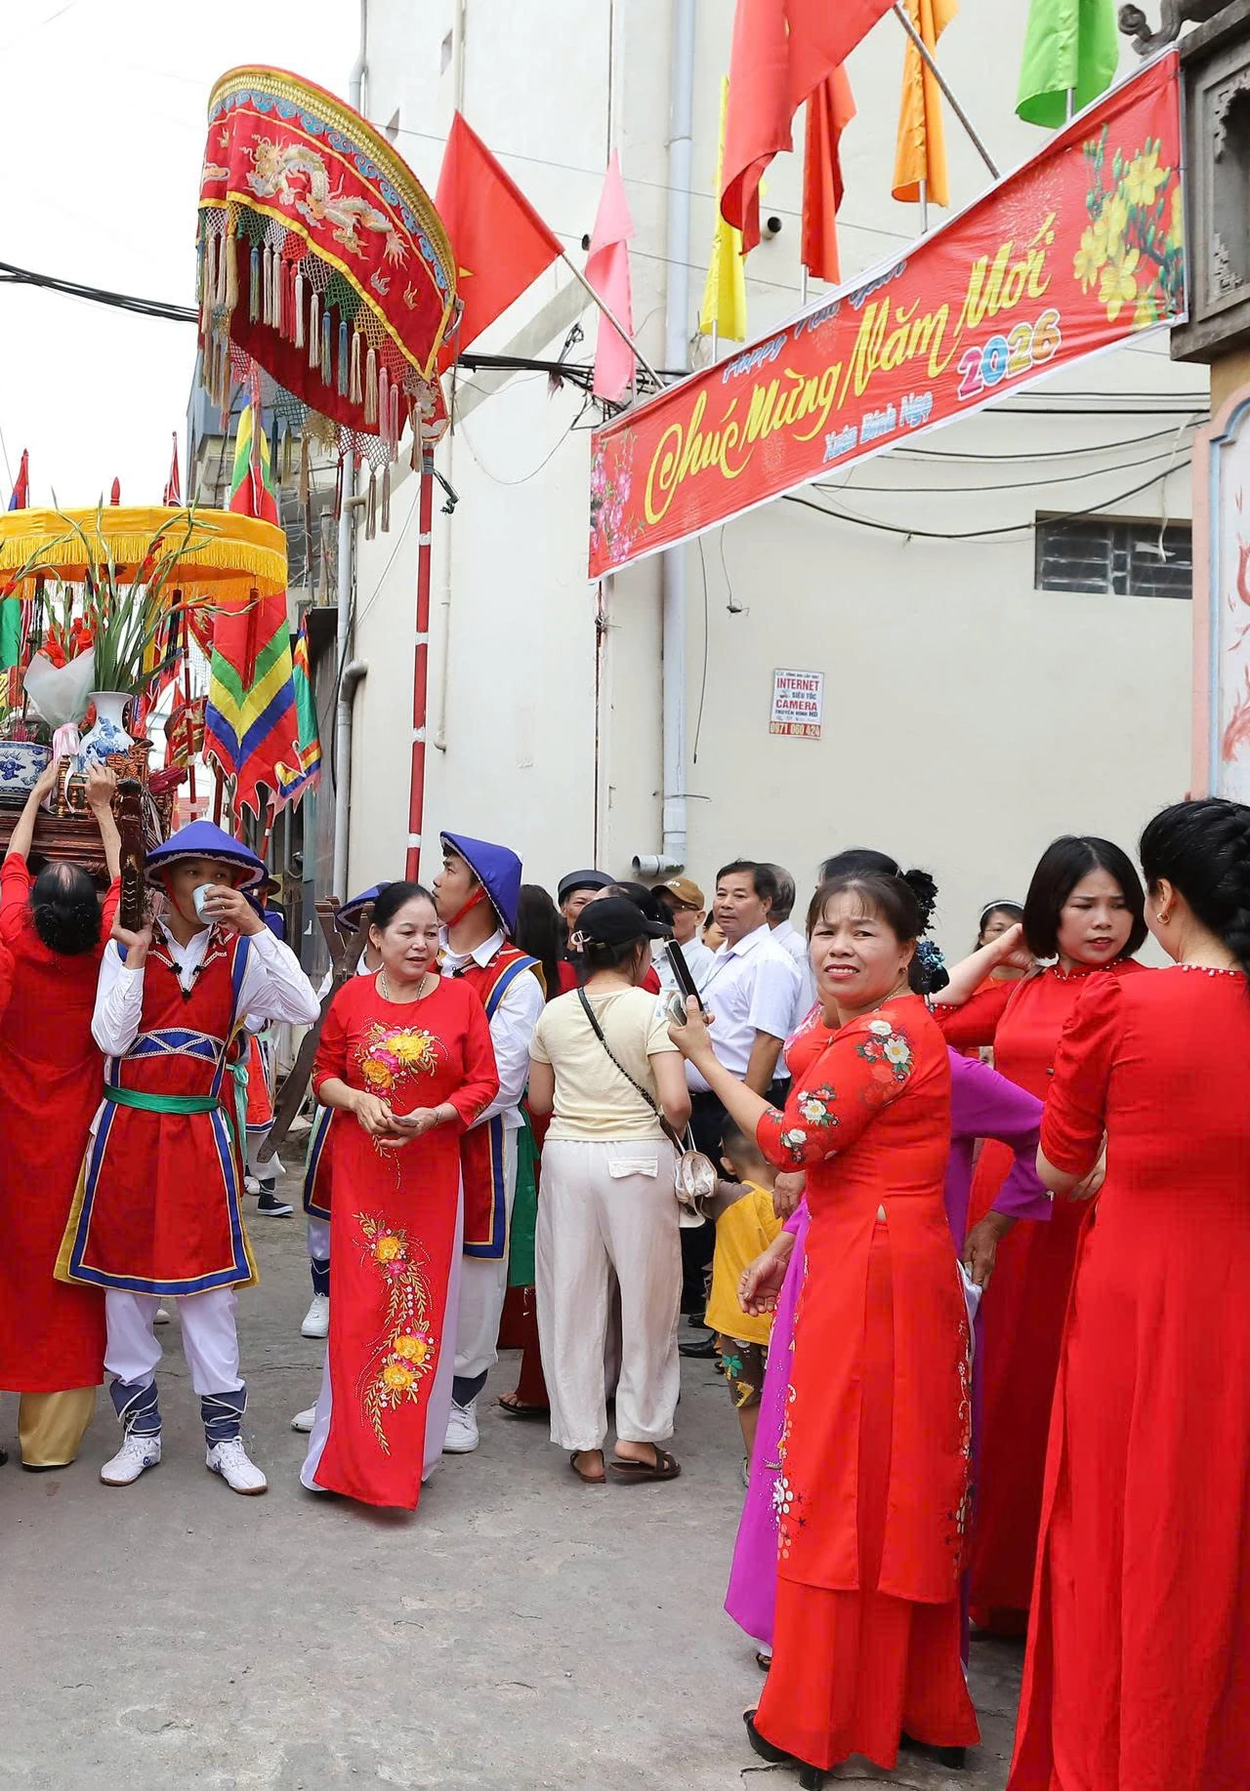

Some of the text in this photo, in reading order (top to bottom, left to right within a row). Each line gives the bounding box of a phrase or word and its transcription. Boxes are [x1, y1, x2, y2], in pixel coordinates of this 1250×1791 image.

[644, 212, 1057, 524] Chúc Mừng Năm Mới
[957, 308, 1061, 402] 2026
[776, 699, 818, 711] CAMERA
[777, 678, 819, 691] INTERNET
